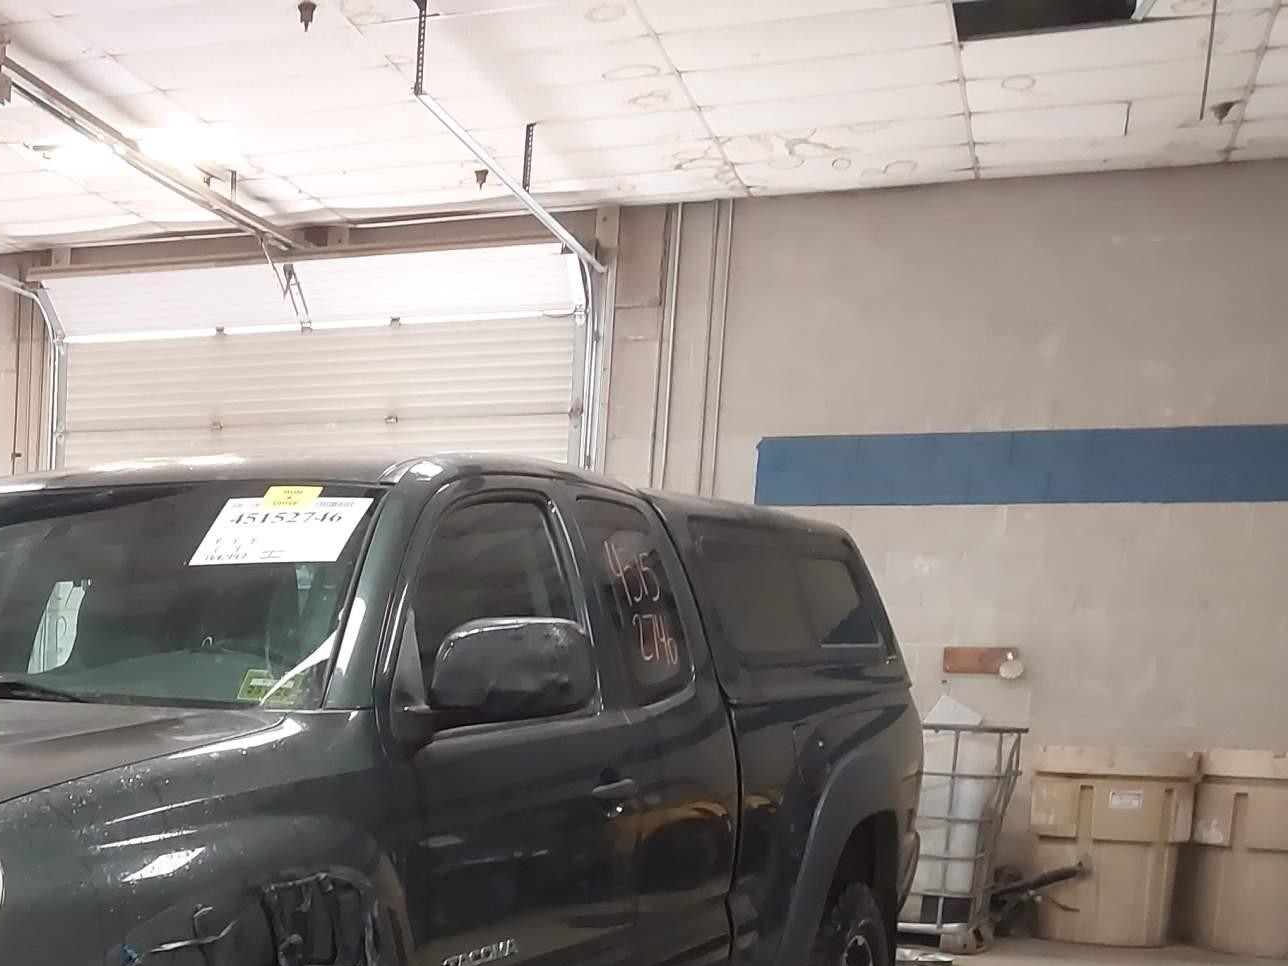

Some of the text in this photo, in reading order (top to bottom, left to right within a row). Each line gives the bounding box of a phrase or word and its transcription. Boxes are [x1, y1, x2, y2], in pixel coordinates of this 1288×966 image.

[229, 511, 344, 525] 45152746
[604, 541, 661, 607] 4515
[632, 613, 679, 666] 2746
